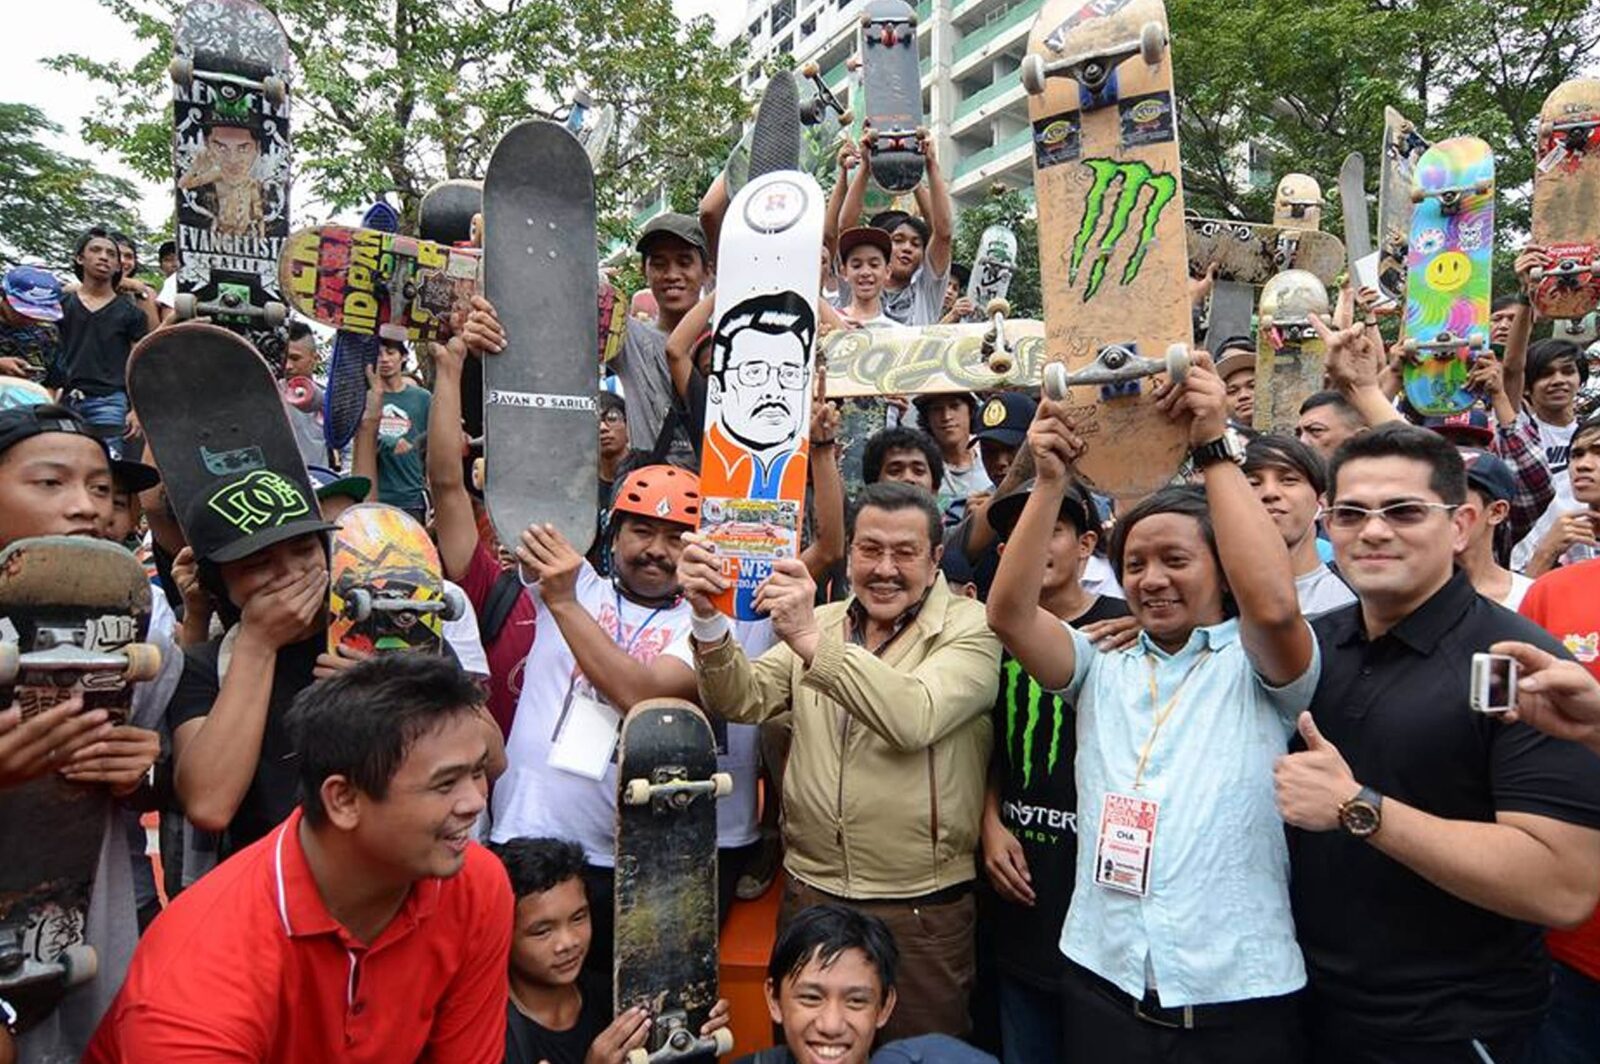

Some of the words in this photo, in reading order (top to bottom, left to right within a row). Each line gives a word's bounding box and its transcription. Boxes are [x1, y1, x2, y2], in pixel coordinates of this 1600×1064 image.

[535, 396, 546, 408] O
[1002, 799, 1077, 833] NSTER
[1116, 830, 1136, 841] CHA
